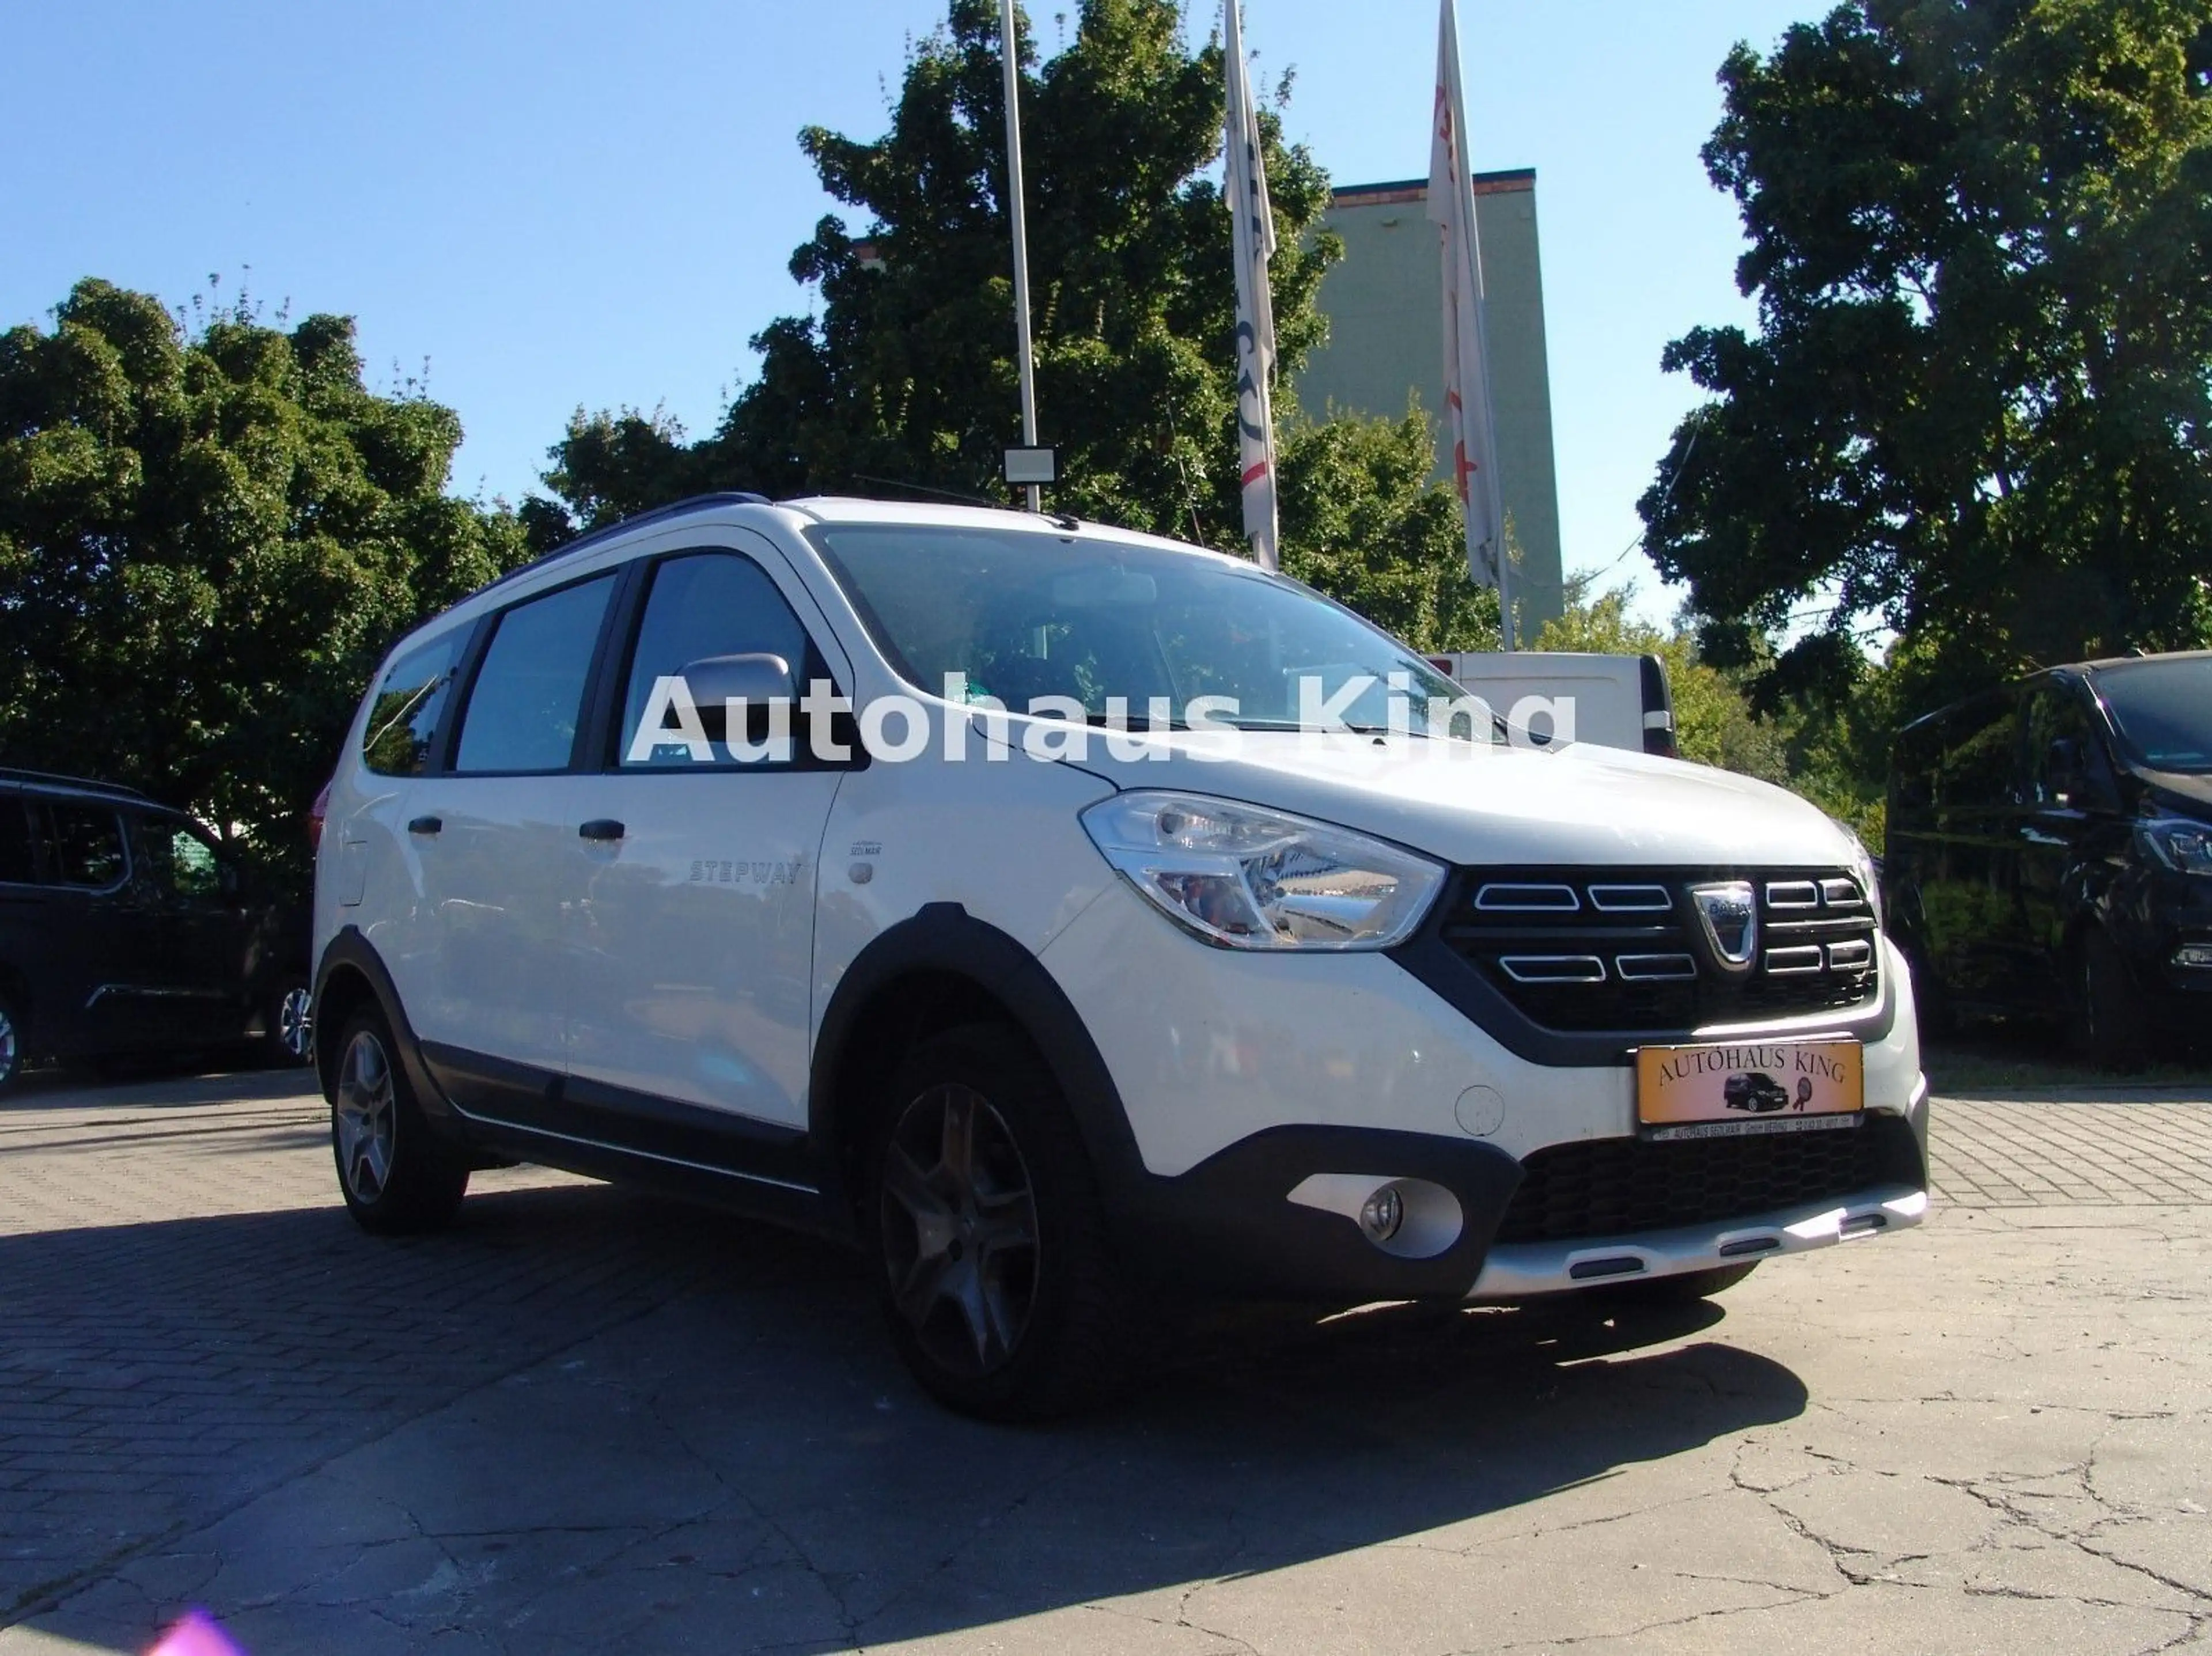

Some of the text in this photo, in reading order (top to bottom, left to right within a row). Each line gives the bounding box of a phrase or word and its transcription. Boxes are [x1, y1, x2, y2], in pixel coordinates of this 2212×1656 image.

[690, 861, 802, 884] STEPWAY
[1659, 1047, 1845, 1086] AUTOHAUS KING
